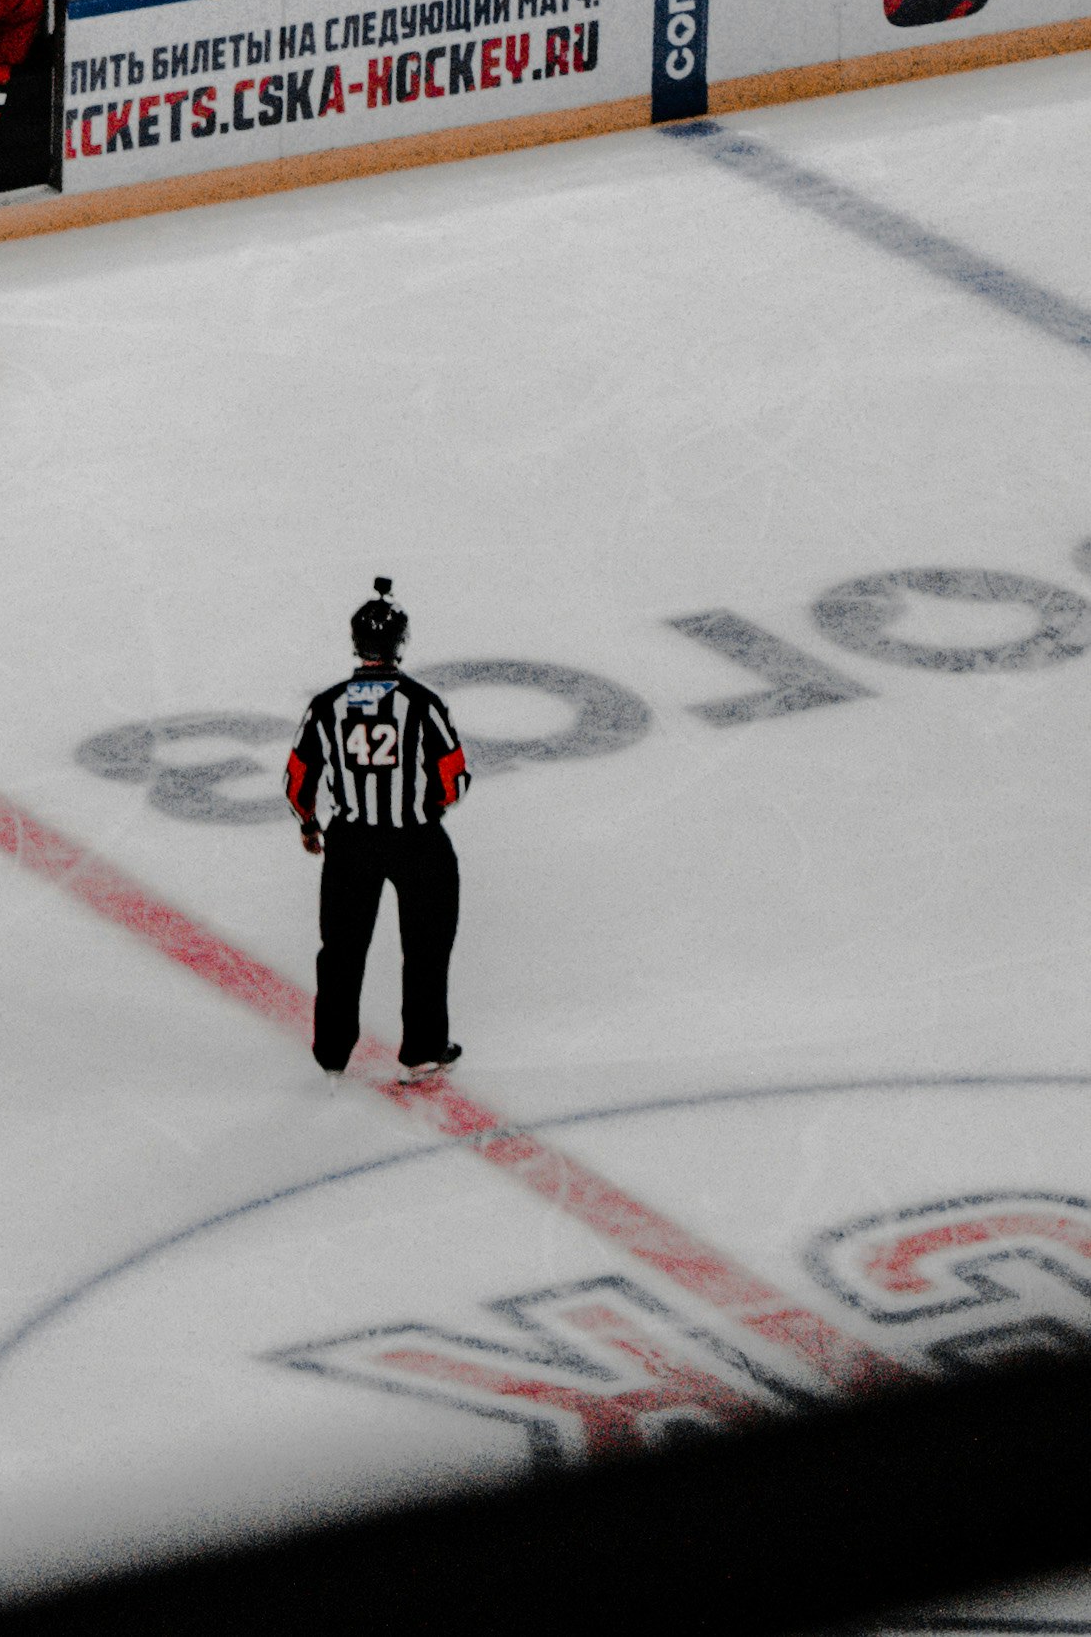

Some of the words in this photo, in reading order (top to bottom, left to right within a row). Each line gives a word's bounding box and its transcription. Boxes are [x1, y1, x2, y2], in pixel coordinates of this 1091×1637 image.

[152, 29, 271, 81] БИЛЕТЫ
[279, 21, 316, 60] НА
[347, 684, 387, 703] SAP
[346, 723, 397, 766] 42
